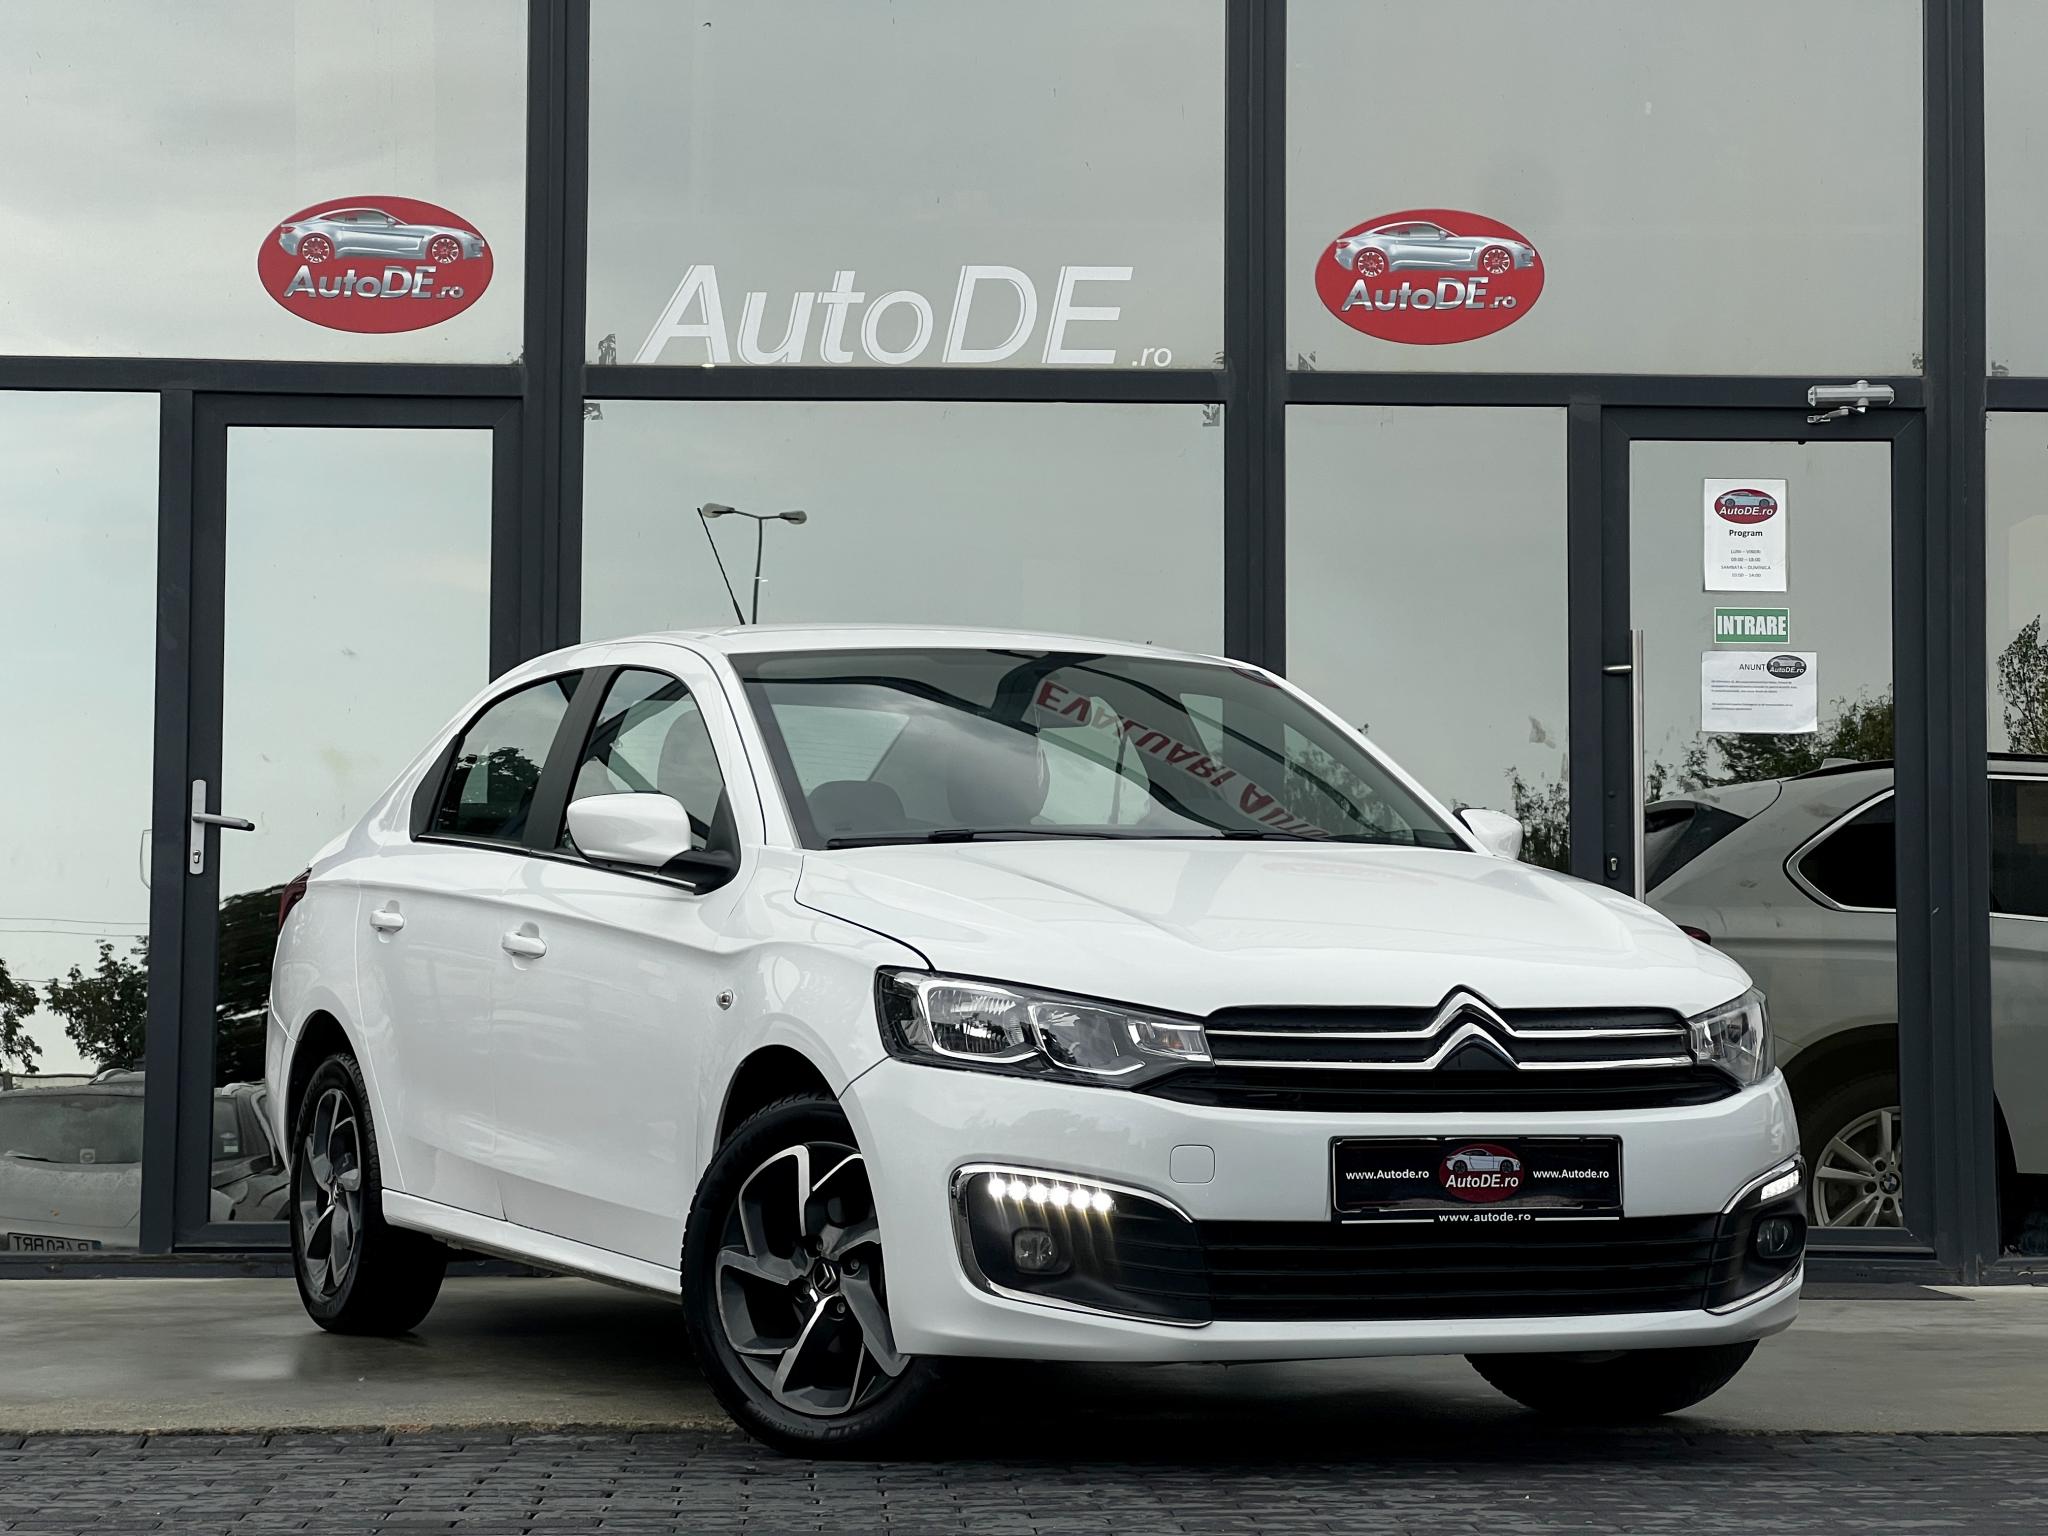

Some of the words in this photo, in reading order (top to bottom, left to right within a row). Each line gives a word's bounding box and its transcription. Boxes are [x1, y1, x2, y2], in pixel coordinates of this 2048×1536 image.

[1718, 505, 1774, 516] AutoDE.ro
[1728, 529, 1763, 539] Program
[1717, 615, 1787, 636] INTRARE
[1345, 1168, 1430, 1180] www.Autode.ro
[1533, 1168, 1609, 1179] www.Autode.ro
[1445, 1174, 1519, 1188] AutoDE.ro
[1438, 1212, 1532, 1222] www.autode.ro
